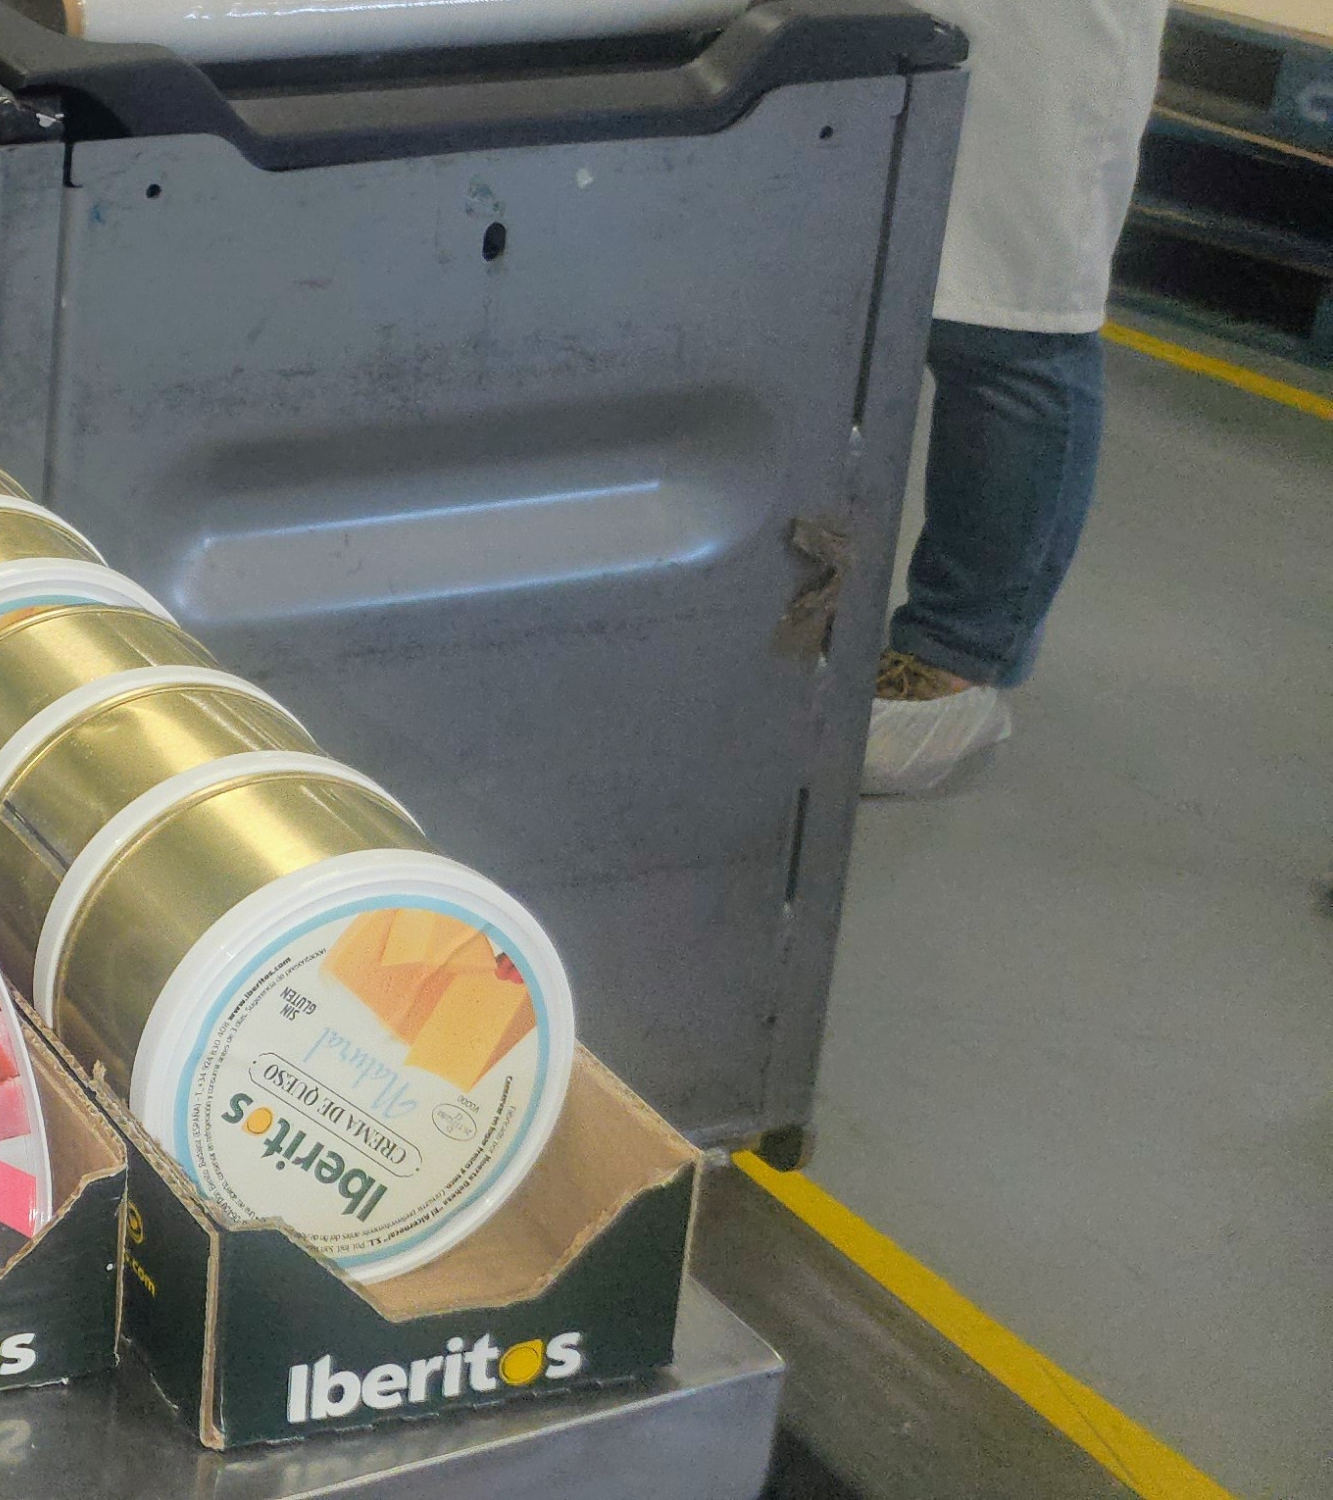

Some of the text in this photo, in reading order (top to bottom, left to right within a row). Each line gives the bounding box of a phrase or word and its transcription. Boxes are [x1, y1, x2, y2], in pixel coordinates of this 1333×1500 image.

[280, 985, 317, 1015] GLUTEN
[280, 1002, 299, 1021] SIN
[261, 1061, 320, 1108] QUESO
[302, 1026, 417, 1122] Natural
[315, 1096, 345, 1124] DE
[220, 1089, 387, 1222] Iberitos
[343, 1114, 409, 1166] CREMA
[442, 1180, 470, 1205] Dehesa
[286, 1331, 582, 1424] Iberitos
